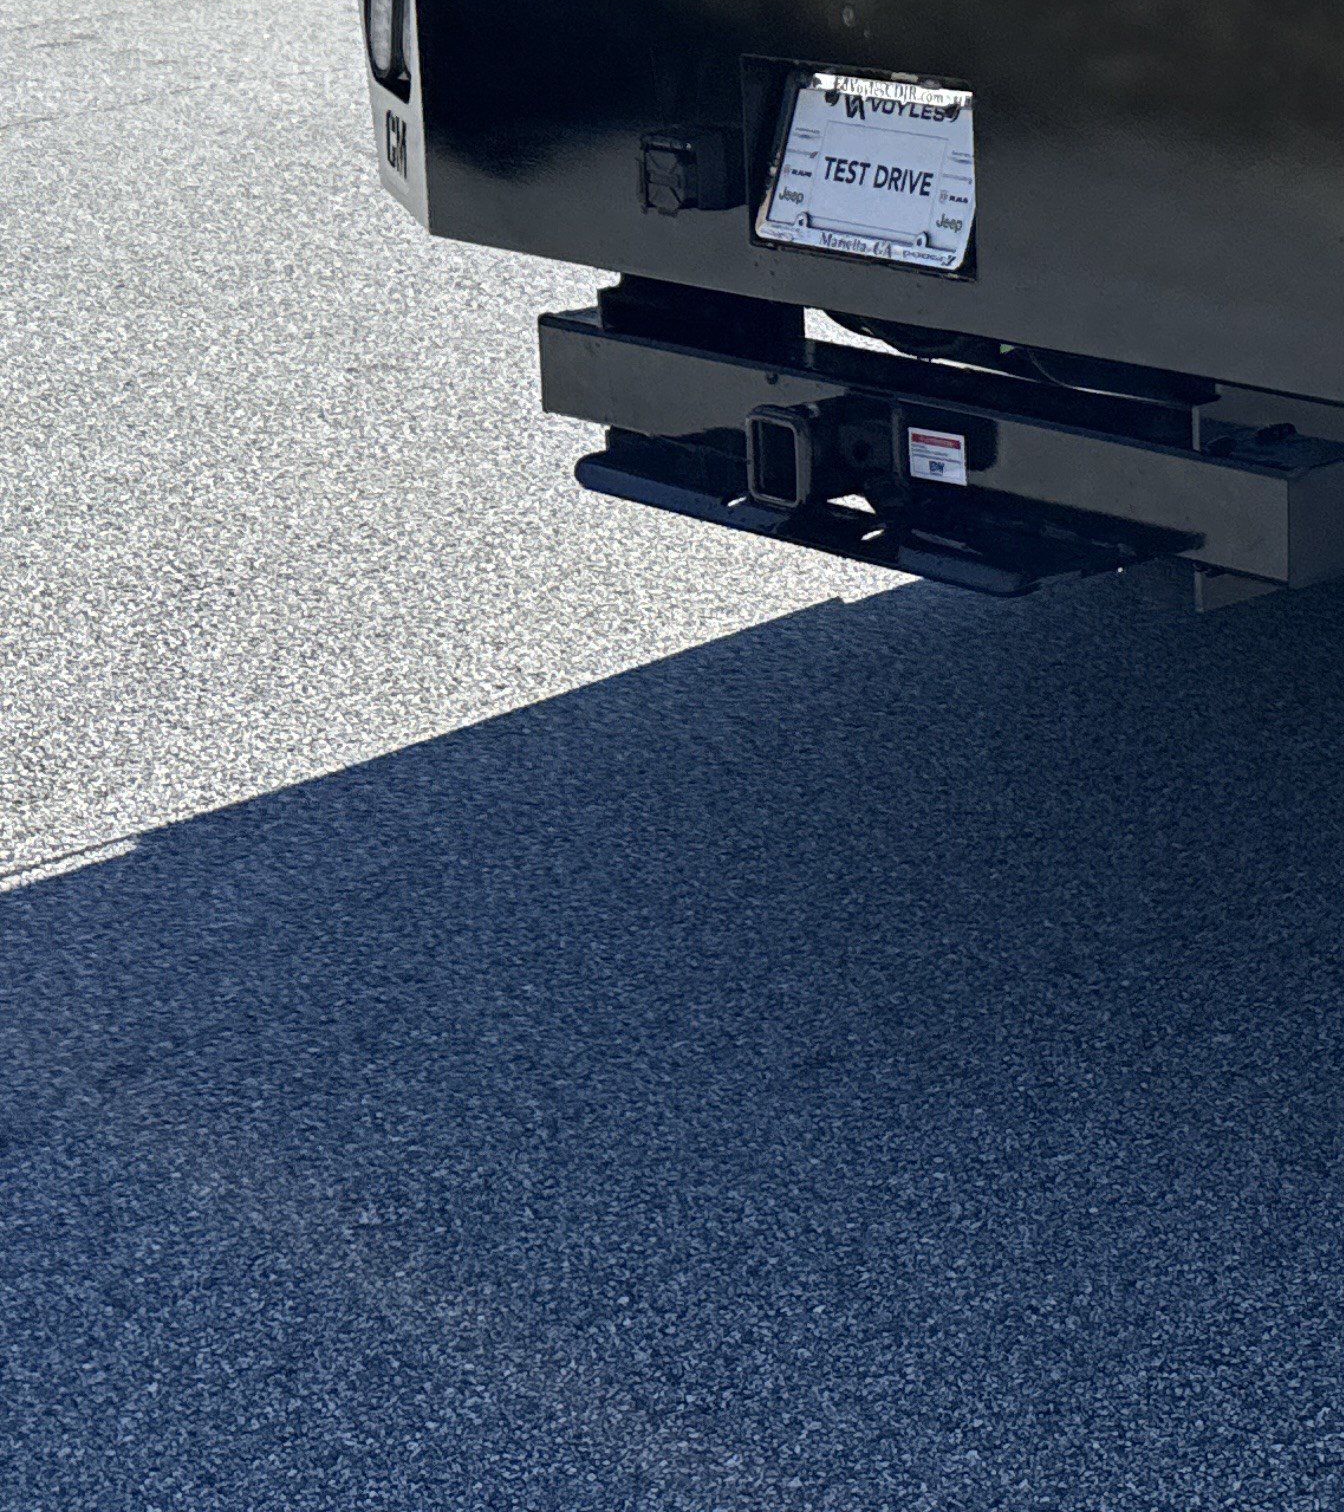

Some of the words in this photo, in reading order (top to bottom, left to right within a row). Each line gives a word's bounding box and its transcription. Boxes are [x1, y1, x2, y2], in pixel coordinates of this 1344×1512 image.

[824, 155, 871, 186] TEST
[873, 164, 934, 197] DRIVE
[779, 186, 804, 204] Jeep
[935, 213, 963, 233] Jeep
